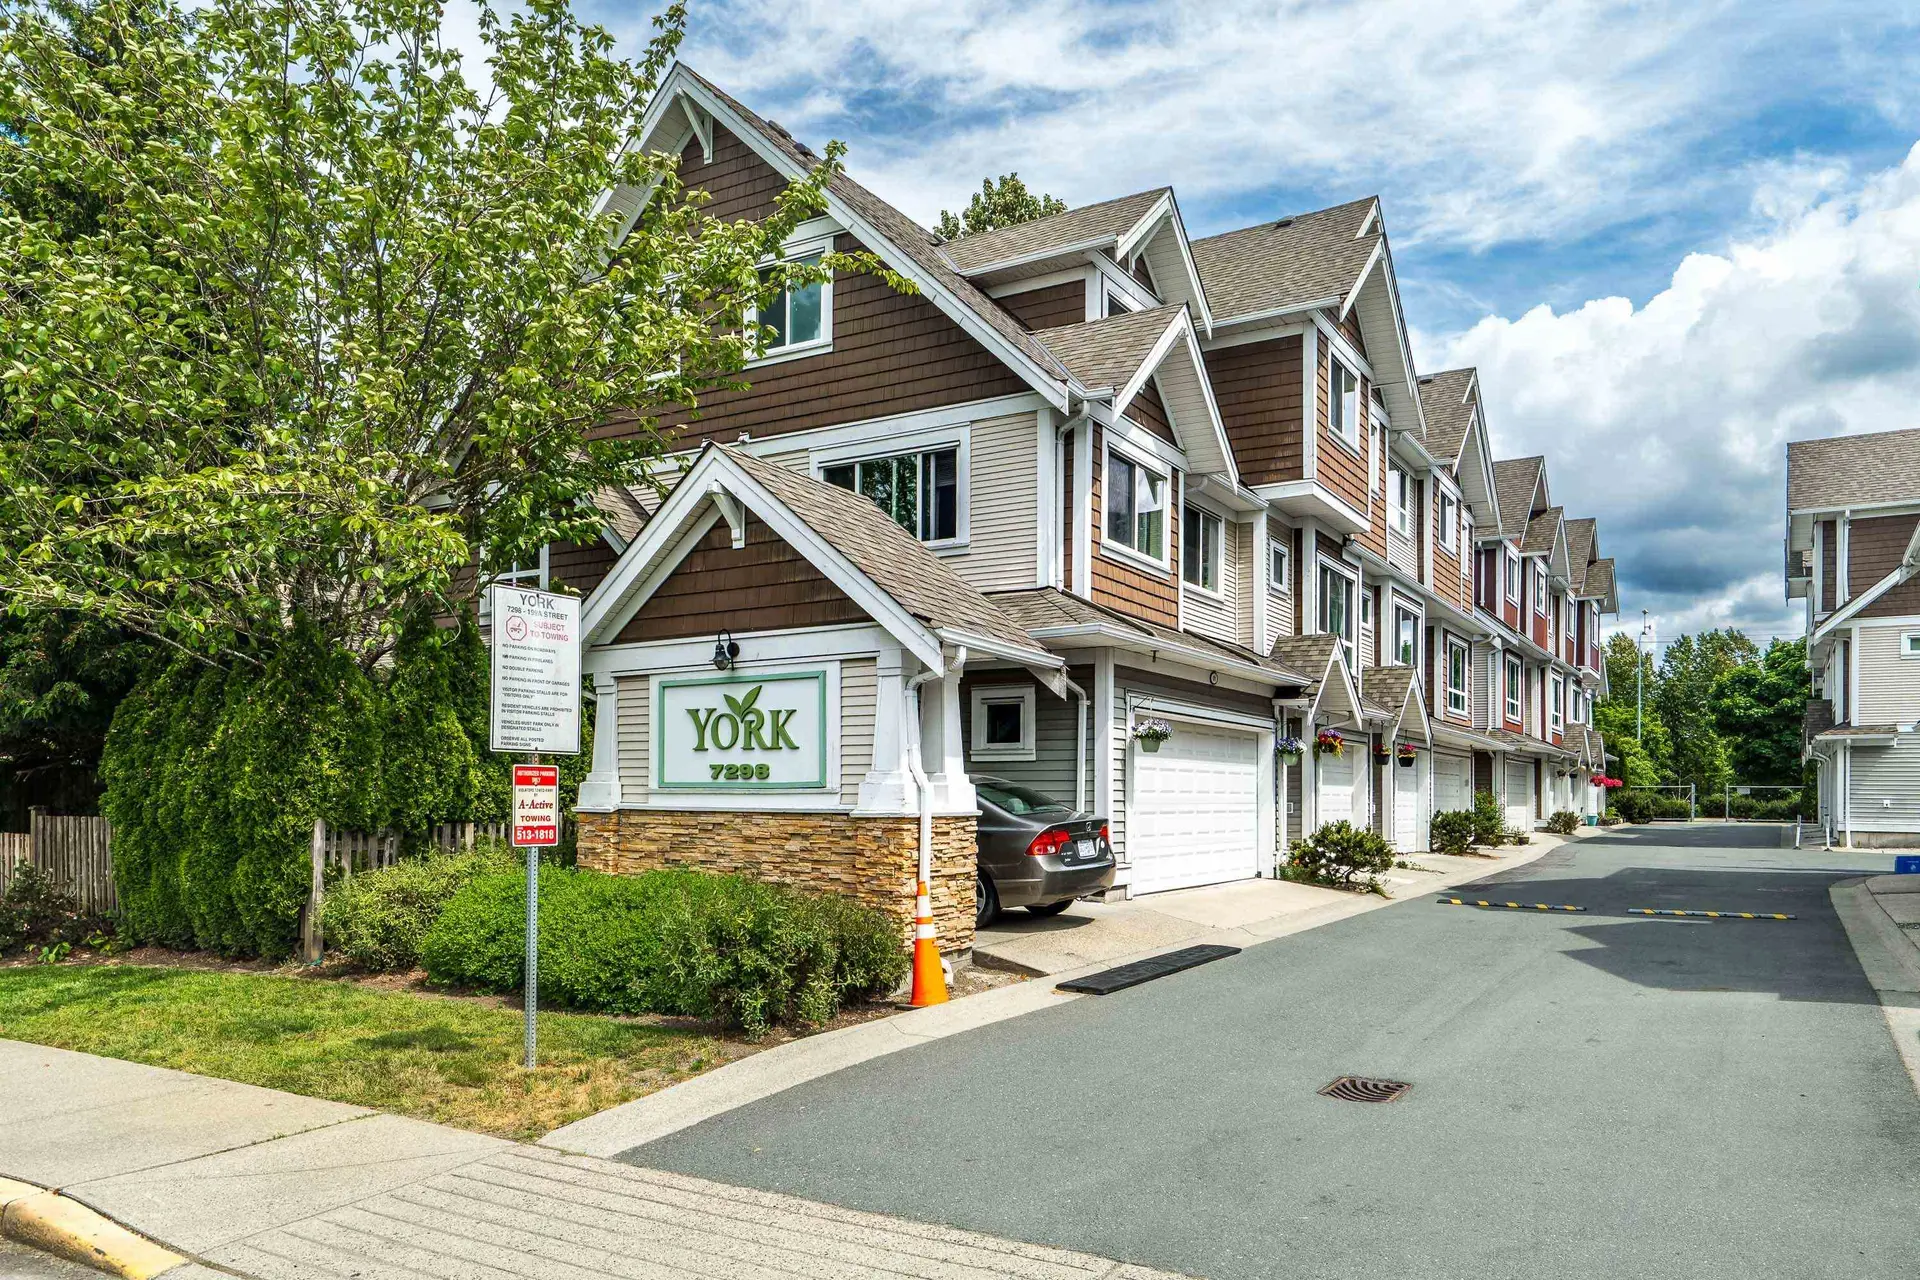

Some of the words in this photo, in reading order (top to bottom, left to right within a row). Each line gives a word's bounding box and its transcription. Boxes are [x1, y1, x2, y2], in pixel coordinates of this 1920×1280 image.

[520, 594, 554, 610] YORK
[544, 611, 568, 620] STREET
[534, 621, 565, 631] SUBJECT
[541, 632, 568, 641] TOWING
[685, 707, 800, 751] YORK
[709, 763, 770, 780] 7298
[518, 799, 553, 809] A-Active
[517, 829, 554, 840] 513-1818
